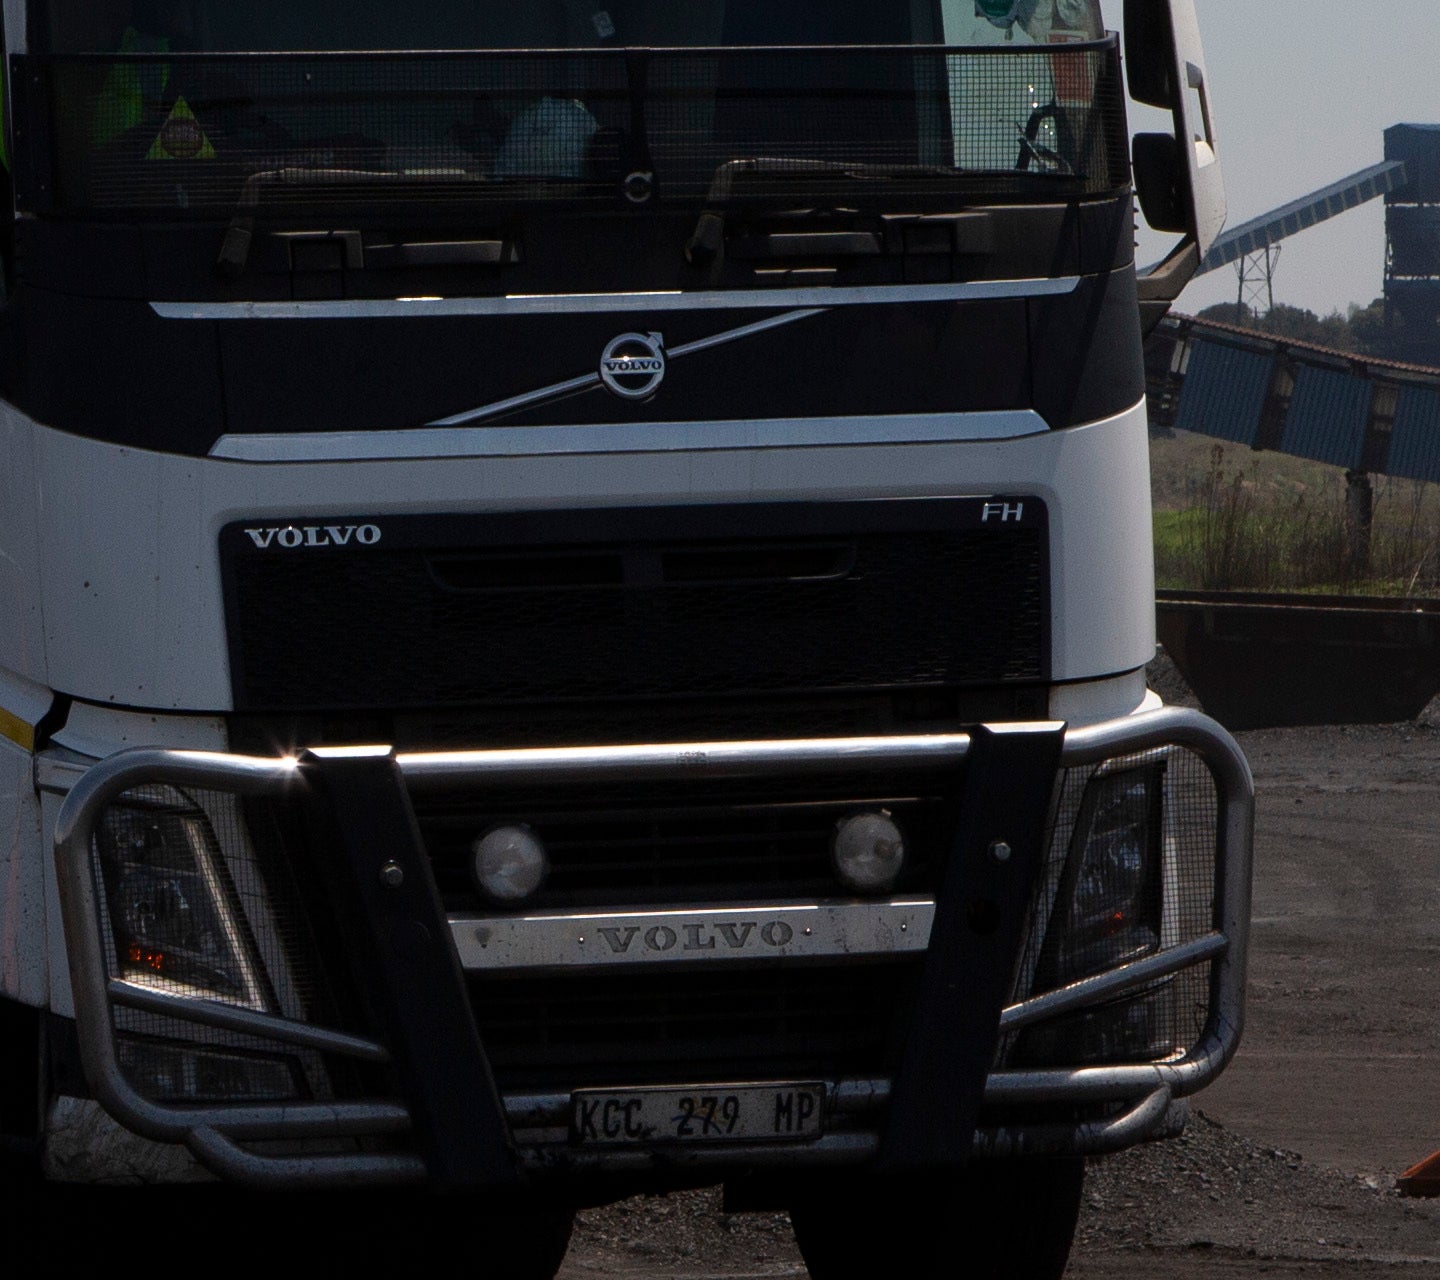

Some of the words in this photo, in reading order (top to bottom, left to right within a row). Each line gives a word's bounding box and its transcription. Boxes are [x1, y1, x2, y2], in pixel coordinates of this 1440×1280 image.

[602, 360, 662, 371] VOLVO
[981, 502, 1024, 523] FH
[243, 523, 382, 548] VOLVO
[596, 920, 794, 953] VOLVO
[580, 1098, 642, 1139] KCC
[676, 1095, 740, 1136] 279
[774, 1092, 815, 1133] MP
